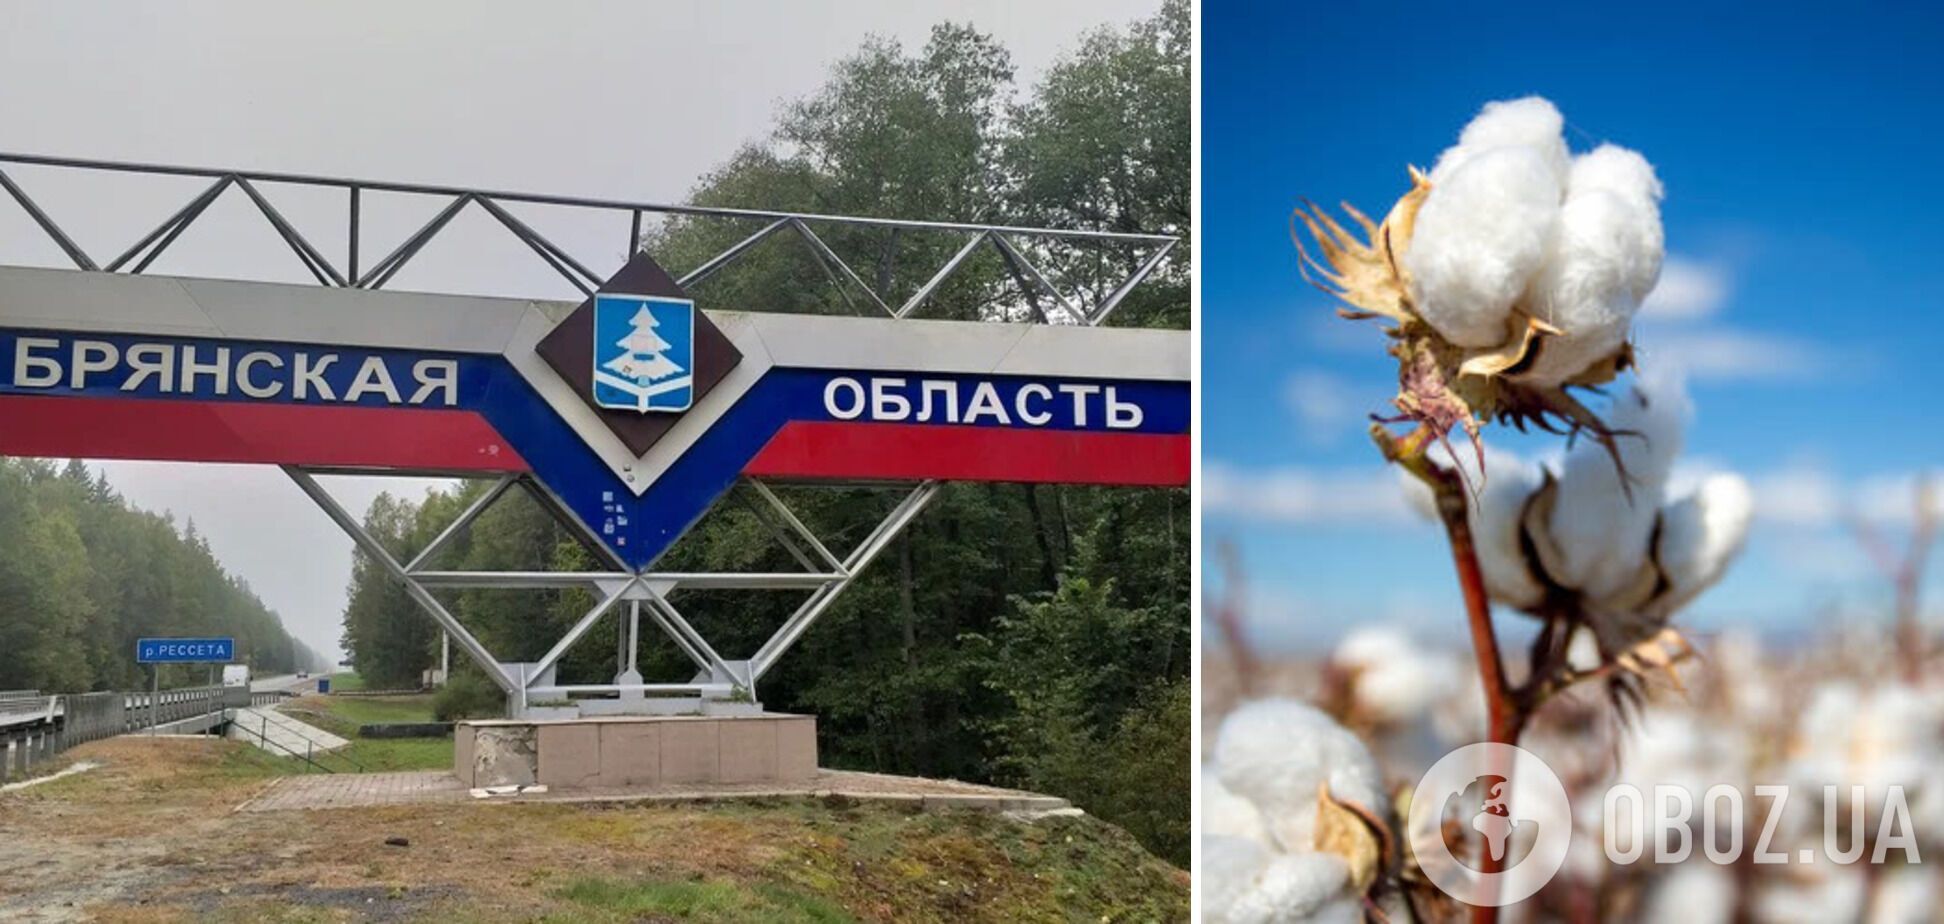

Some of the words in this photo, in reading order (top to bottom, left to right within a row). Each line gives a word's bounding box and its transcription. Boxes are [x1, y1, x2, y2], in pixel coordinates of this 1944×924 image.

[13, 336, 459, 406] БРЯНСКАЯ
[823, 376, 1145, 429] ОБЛАСТЬ
[159, 644, 225, 656] РЕССЕТА
